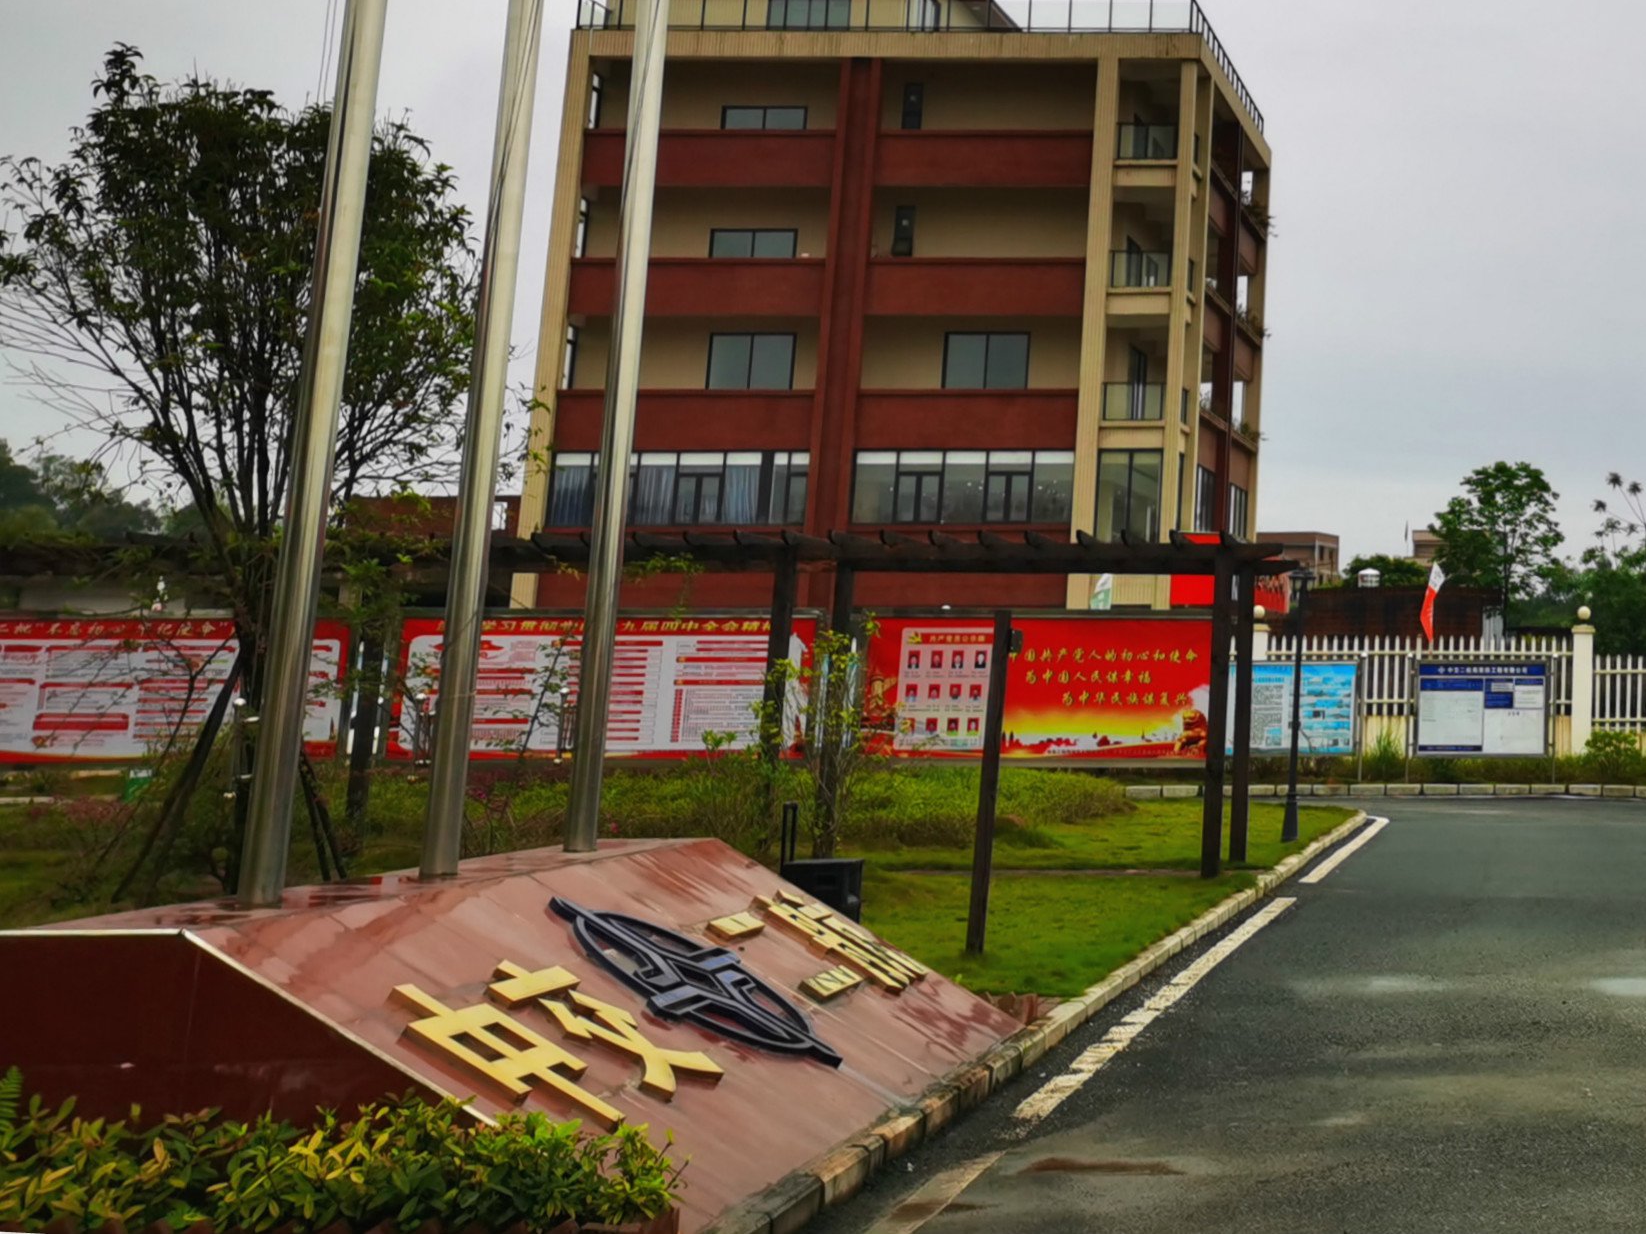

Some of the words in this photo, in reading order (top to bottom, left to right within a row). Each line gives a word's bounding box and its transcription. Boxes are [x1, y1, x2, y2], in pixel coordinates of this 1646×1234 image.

[1025, 669, 1153, 684] 为中国人民谋幸福
[1061, 691, 1190, 707] 为中华民族谋复兴
[388, 958, 725, 1133] 中交
